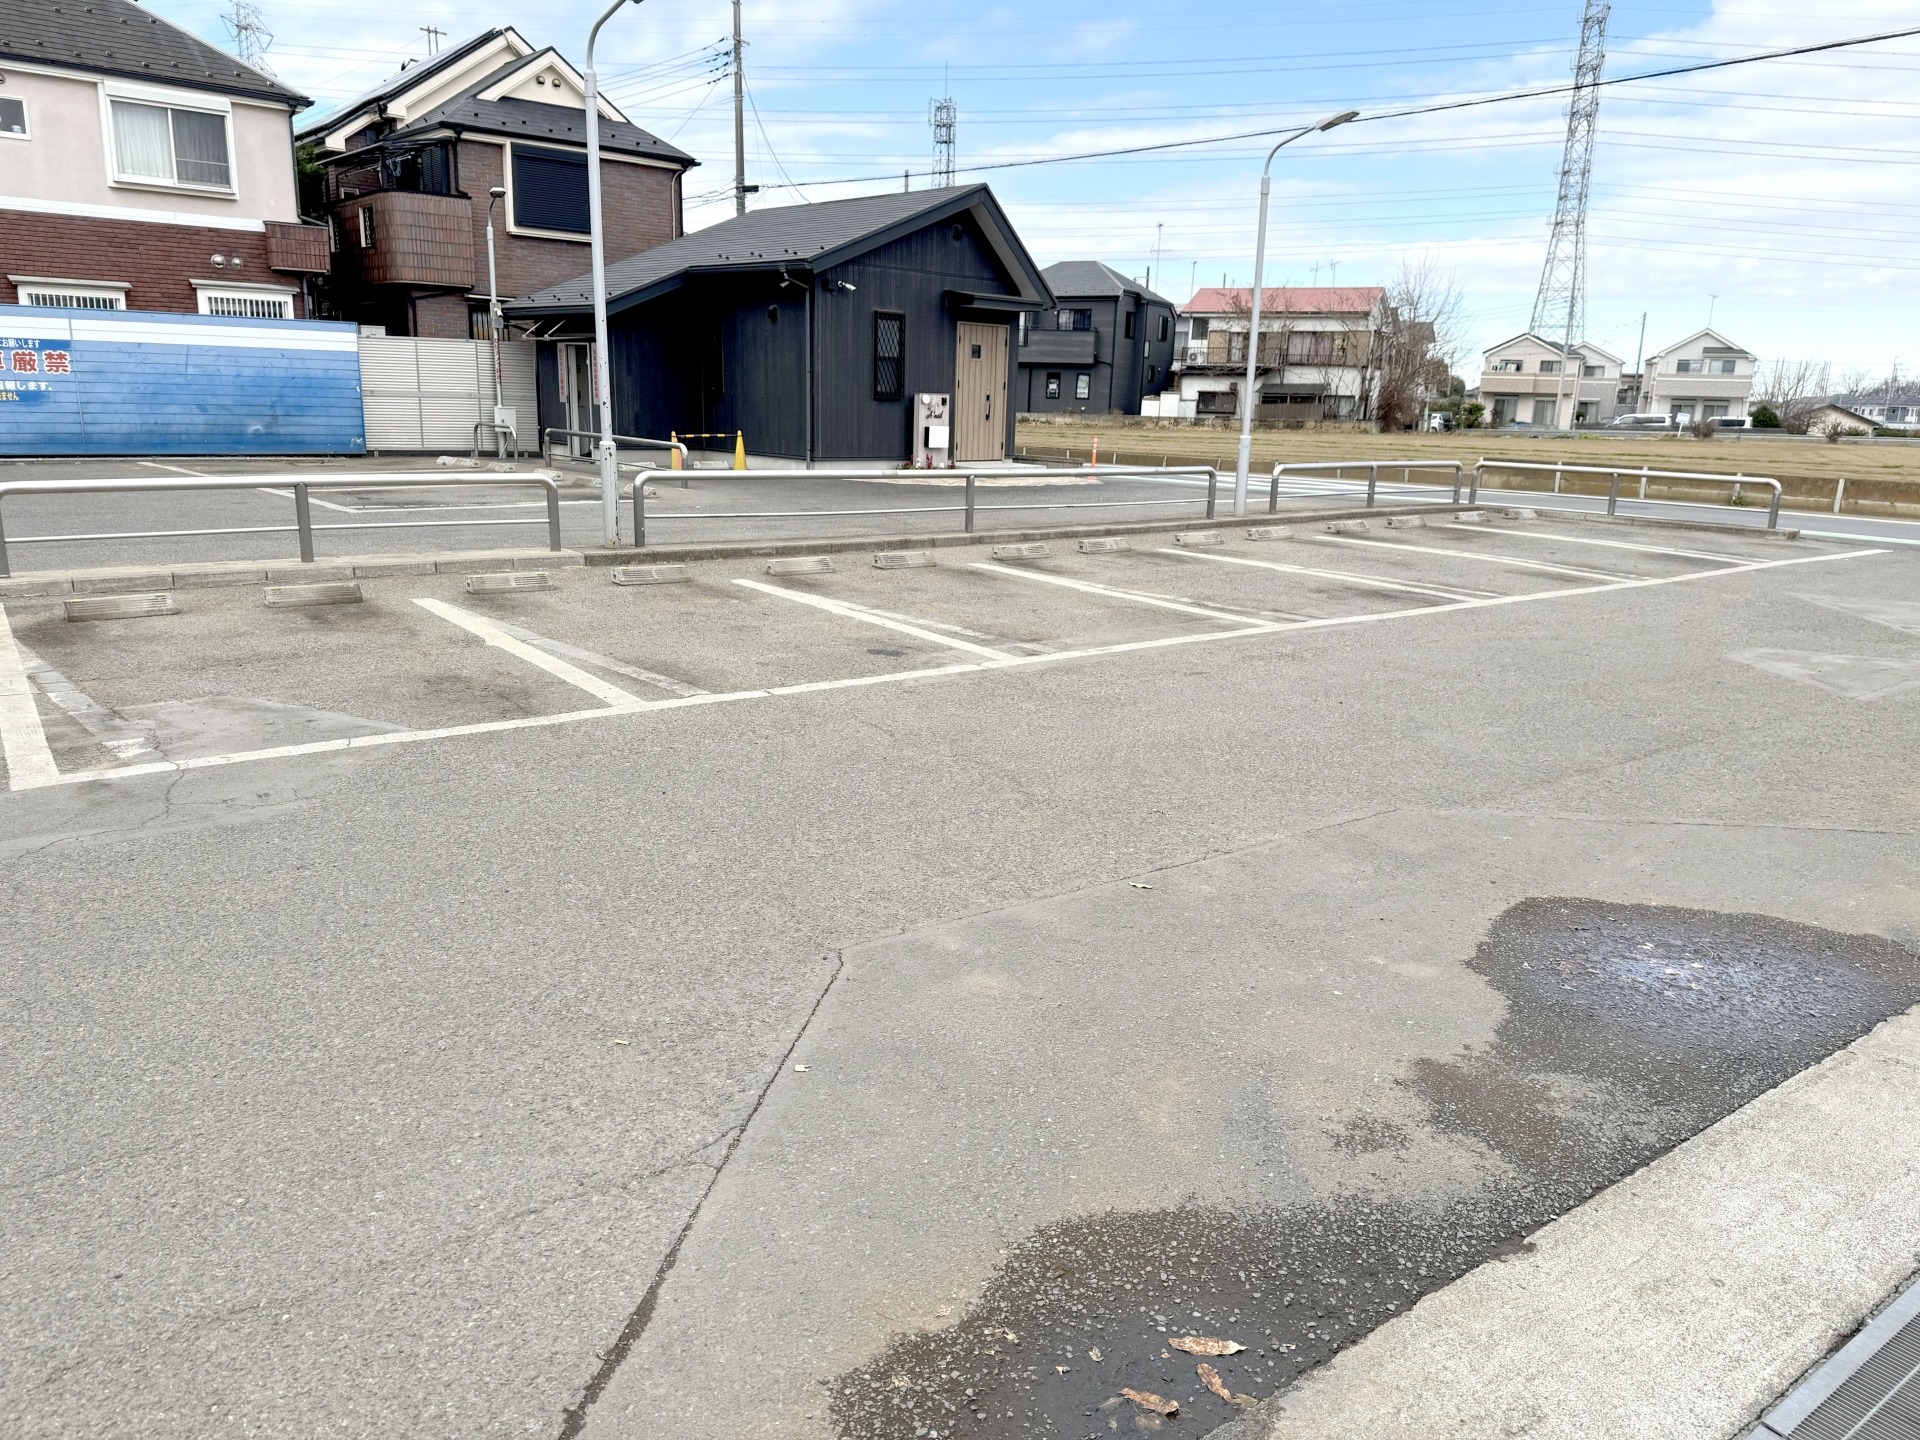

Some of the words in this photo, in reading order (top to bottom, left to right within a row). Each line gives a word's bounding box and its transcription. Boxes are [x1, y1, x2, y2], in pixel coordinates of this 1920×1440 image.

[0, 338, 40, 349] お願いします
[0, 349, 70, 374] 厳禁
[0, 391, 20, 401] ません
